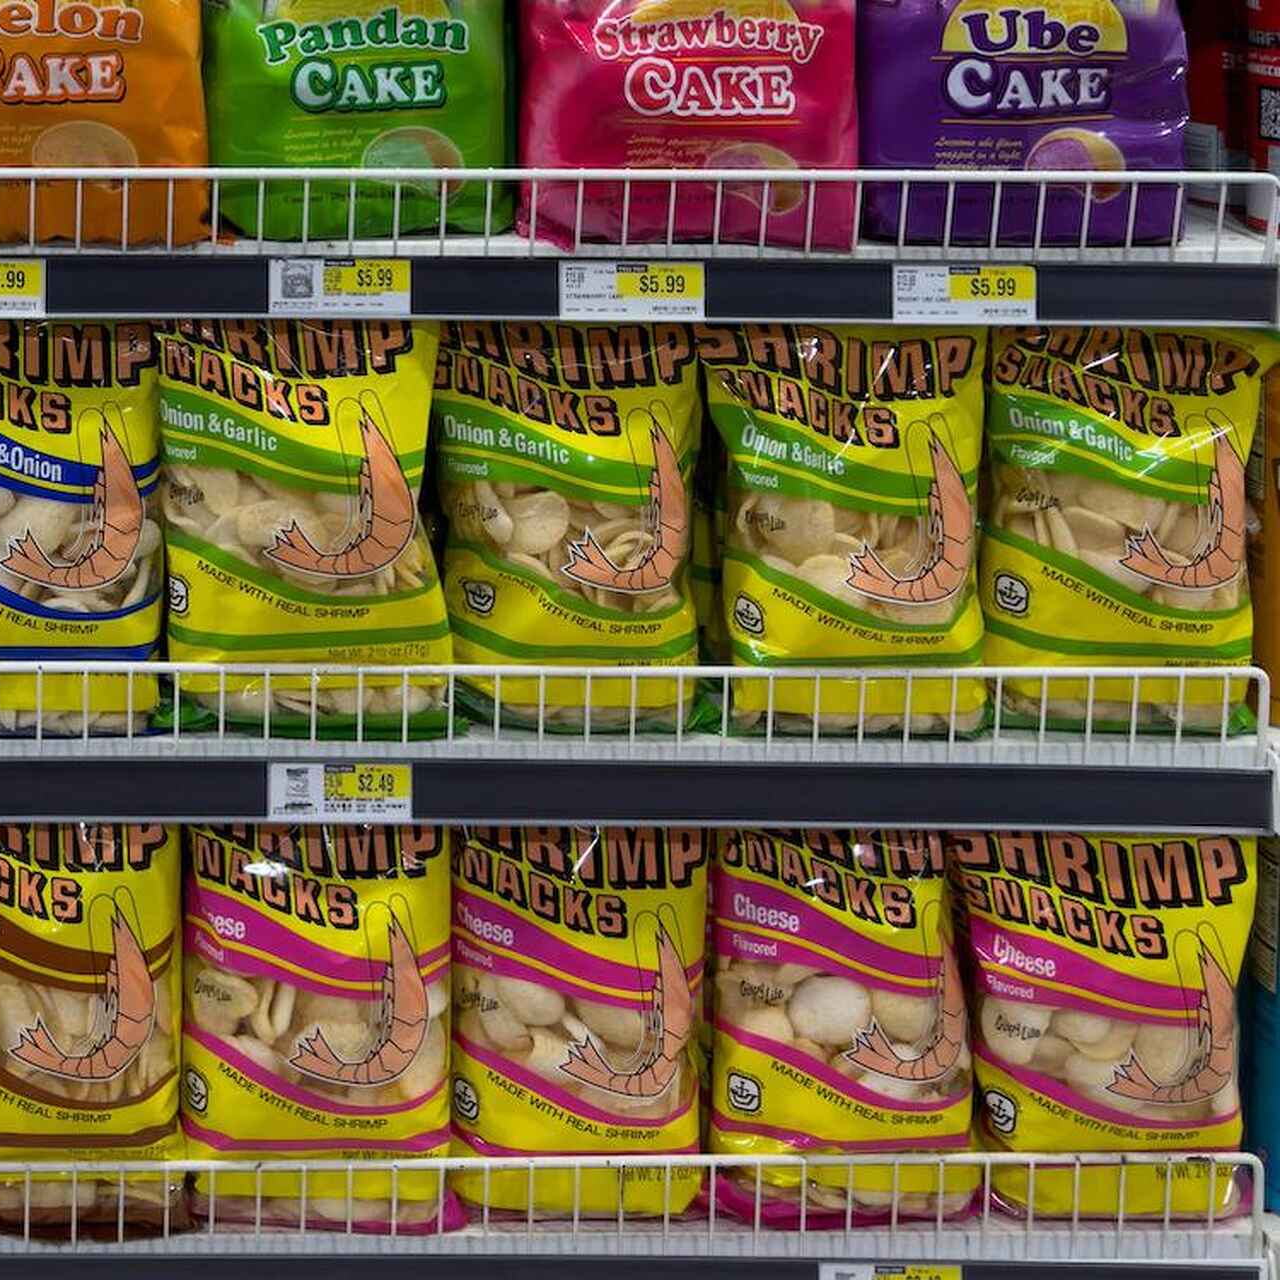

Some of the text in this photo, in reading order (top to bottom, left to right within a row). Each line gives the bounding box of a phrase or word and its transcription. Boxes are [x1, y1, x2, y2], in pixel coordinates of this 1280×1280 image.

[259, 6, 468, 65] Pandan
[593, 12, 824, 64] Strawberry
[961, 9, 1101, 56] Ube
[291, 57, 447, 112] CAKE
[626, 57, 797, 115] CAKE
[946, 58, 1110, 113] CAKE
[356, 269, 393, 288] $5.99
[638, 275, 686, 295] $5.99
[970, 276, 1017, 296] $5.99
[695, 324, 973, 401] SHRIMP
[995, 343, 1180, 438] SNACKS
[443, 413, 495, 447] Onion
[514, 428, 570, 465] Garlic
[1040, 564, 1214, 635] MADE WITH REAL SHRIMP
[357, 774, 394, 793] $2.49
[951, 831, 1247, 908] SHRIMP
[733, 892, 801, 933] Cheese
[966, 874, 1168, 959] SNACKS
[732, 933, 778, 958] Flavored
[992, 933, 1058, 978] Cheese
[770, 1060, 944, 1126] MADE WITH REAL SHRIMP
